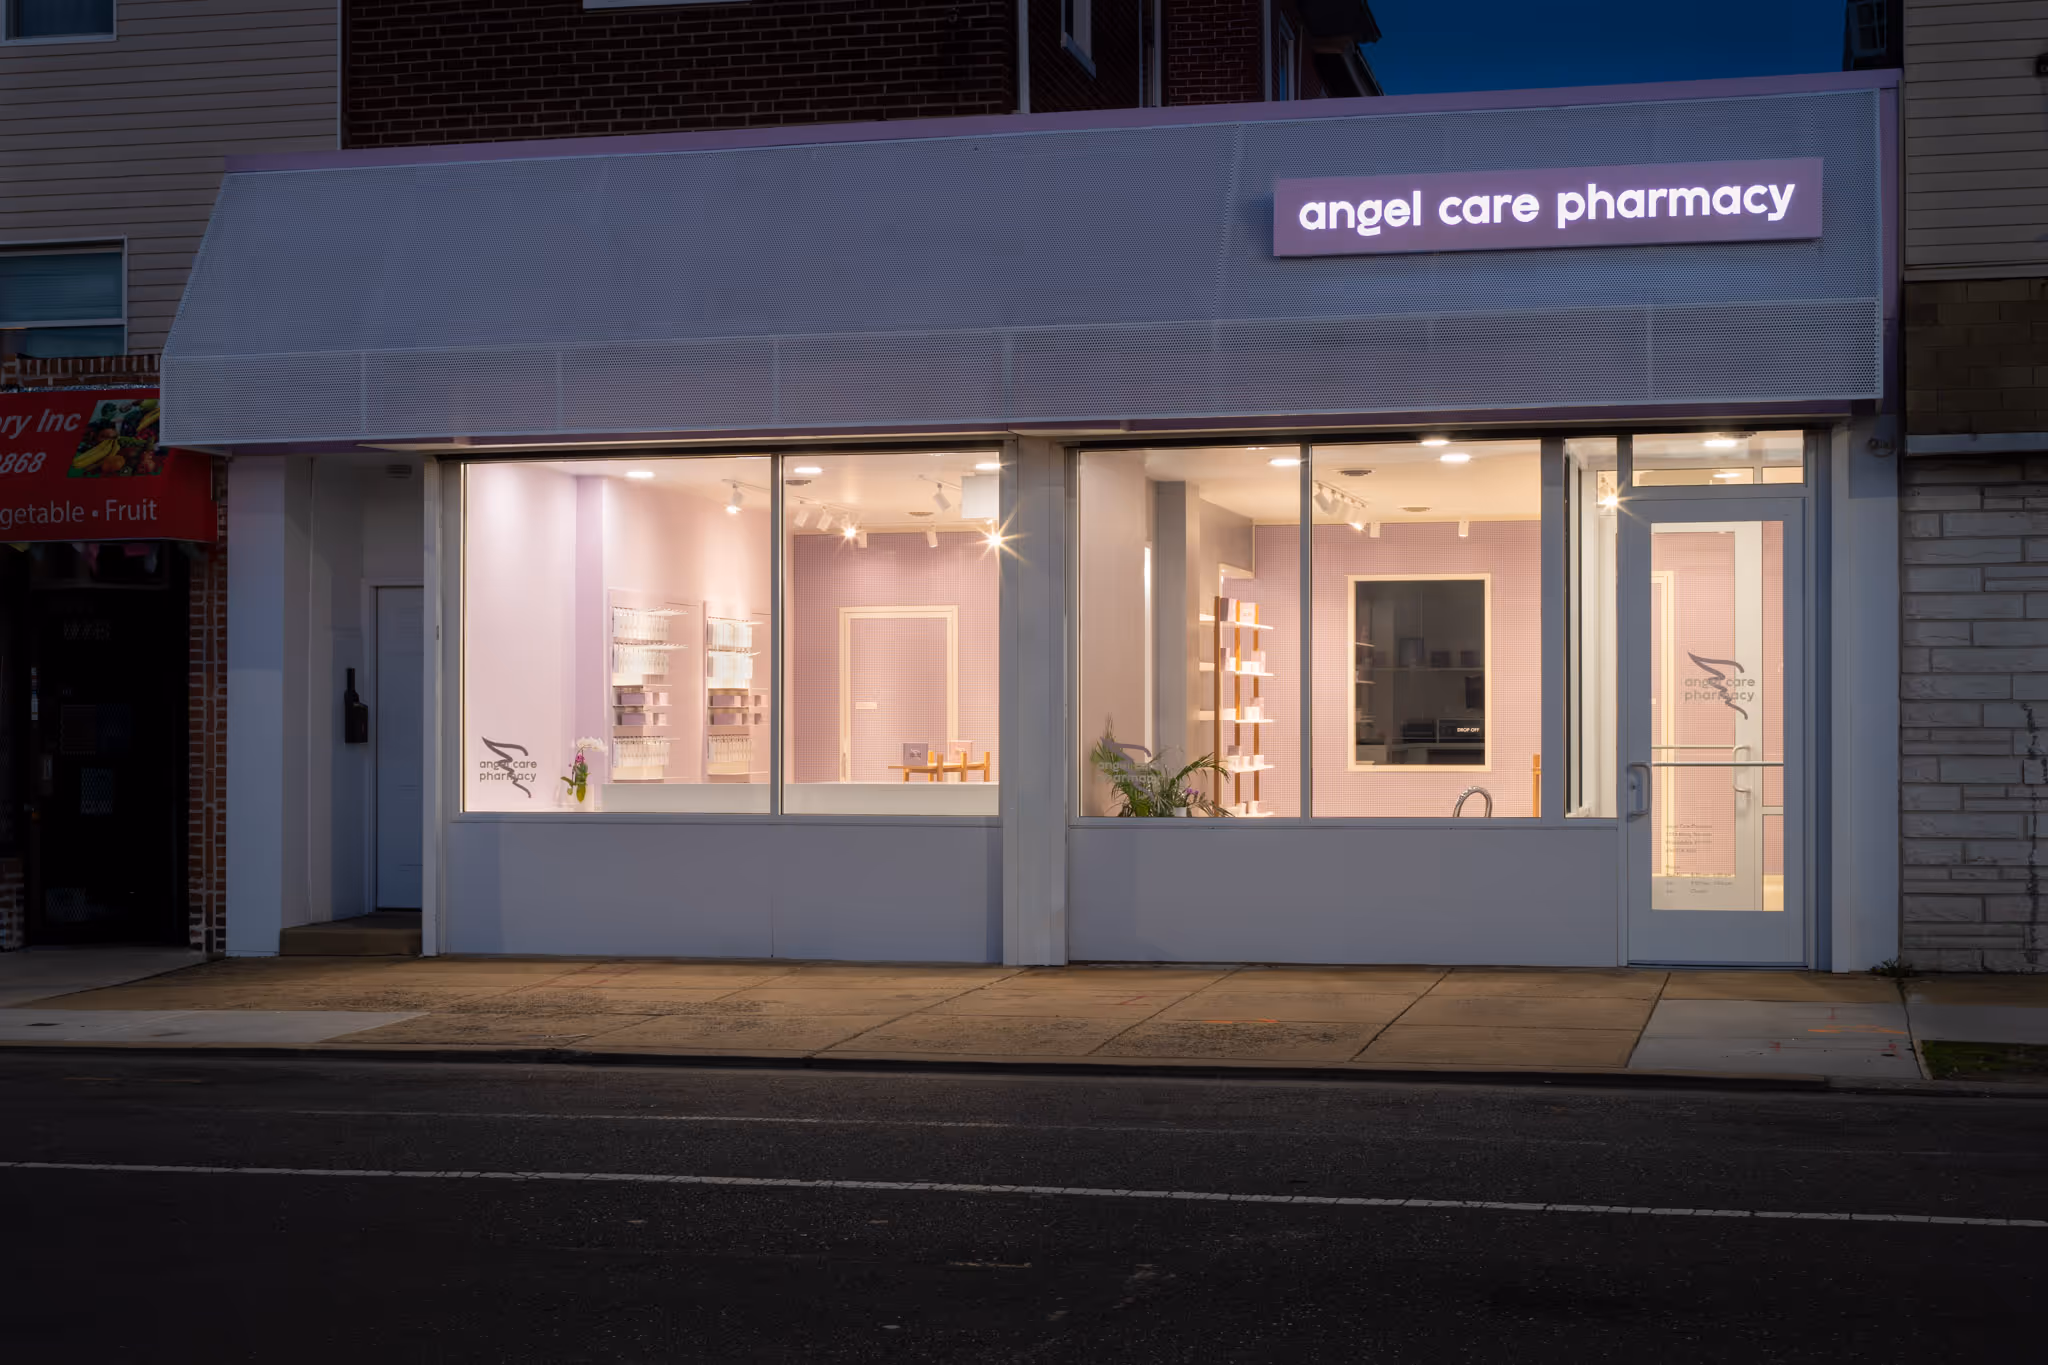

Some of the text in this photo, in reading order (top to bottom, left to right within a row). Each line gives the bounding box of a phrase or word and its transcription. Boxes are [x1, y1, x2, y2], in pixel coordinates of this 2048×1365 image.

[1299, 183, 1796, 237] angel care pharmacy
[0, 408, 81, 440] ry Inc
[0, 451, 47, 474] 868
[0, 498, 157, 530] getable Fruit
[1726, 678, 1756, 687] care
[512, 760, 538, 769] care
